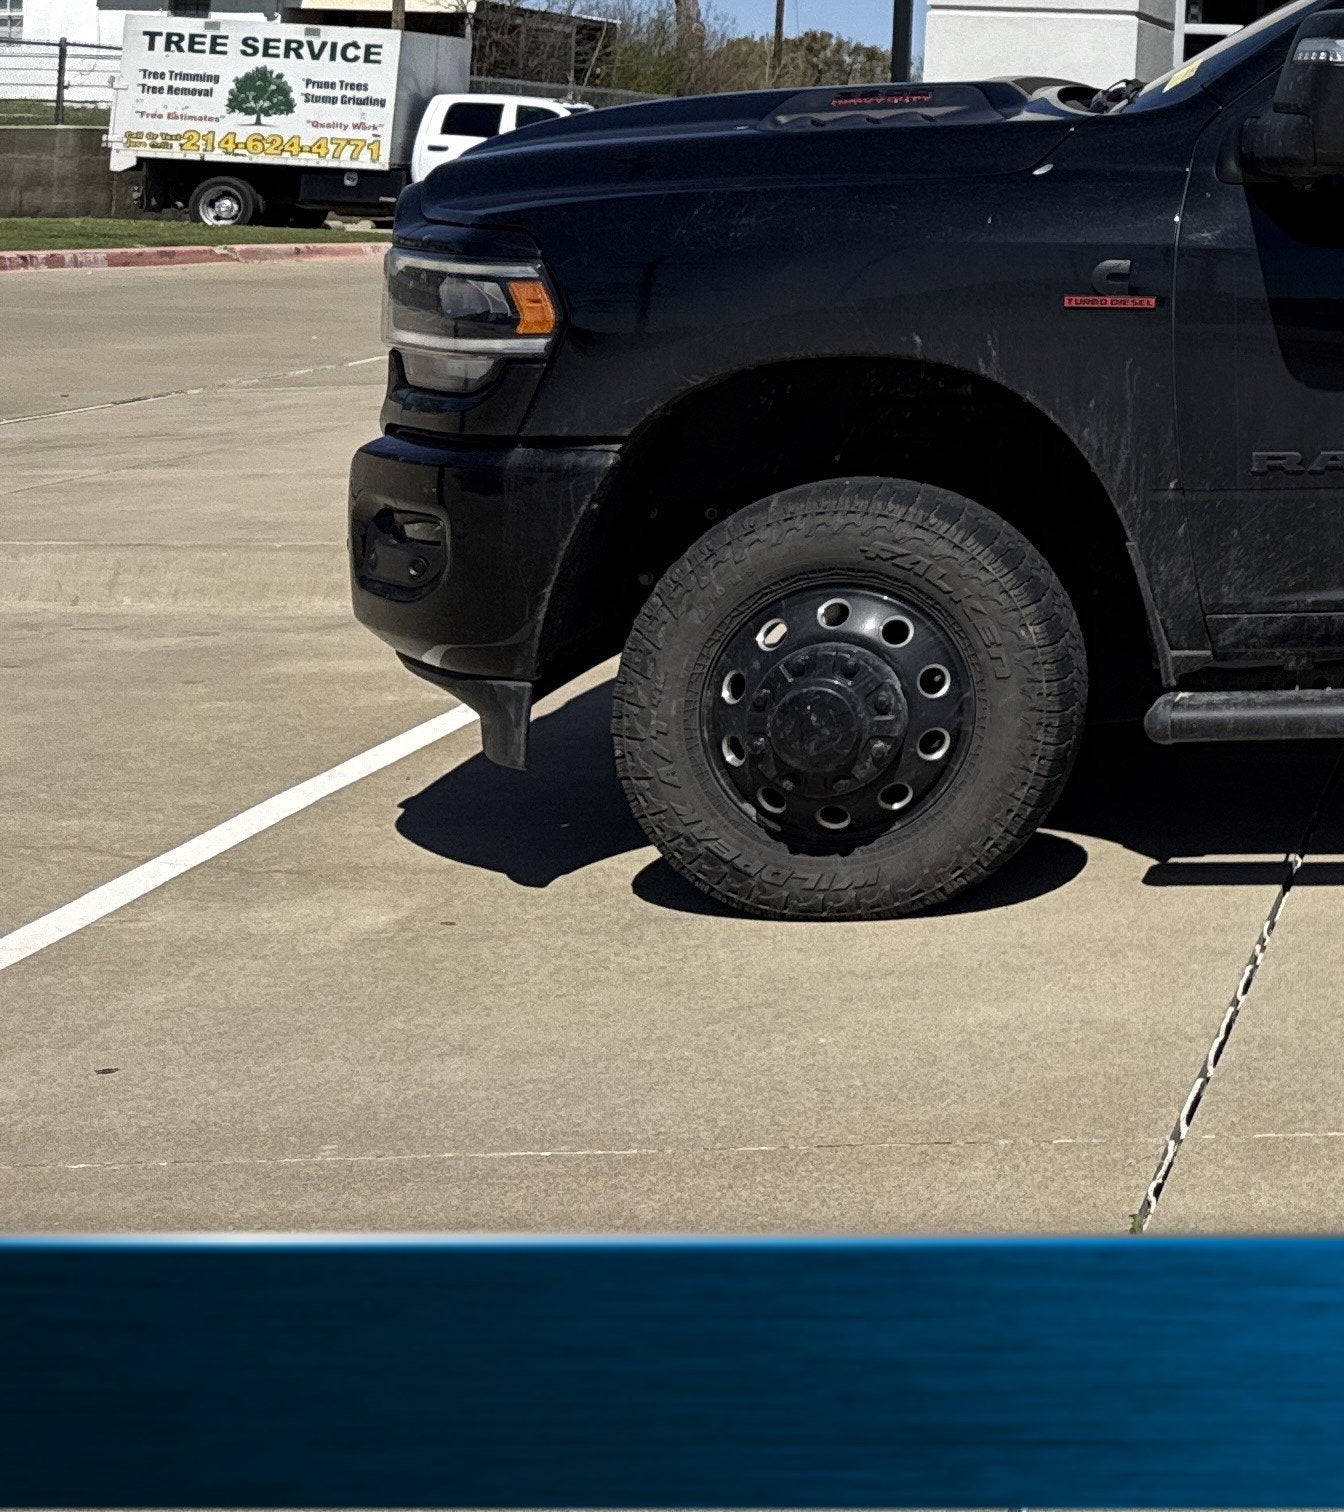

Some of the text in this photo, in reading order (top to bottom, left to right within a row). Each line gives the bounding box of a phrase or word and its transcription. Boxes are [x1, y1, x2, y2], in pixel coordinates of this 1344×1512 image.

[142, 30, 384, 65] TREE SERVICE
[168, 69, 220, 85] Trimming
[167, 85, 214, 98] Removal
[338, 80, 369, 92] Trees
[340, 94, 387, 109] Grinding
[180, 129, 382, 164] 214-624-4771
[1064, 297, 1154, 307] TURBO DIESEL
[859, 541, 1013, 680] FALKEN
